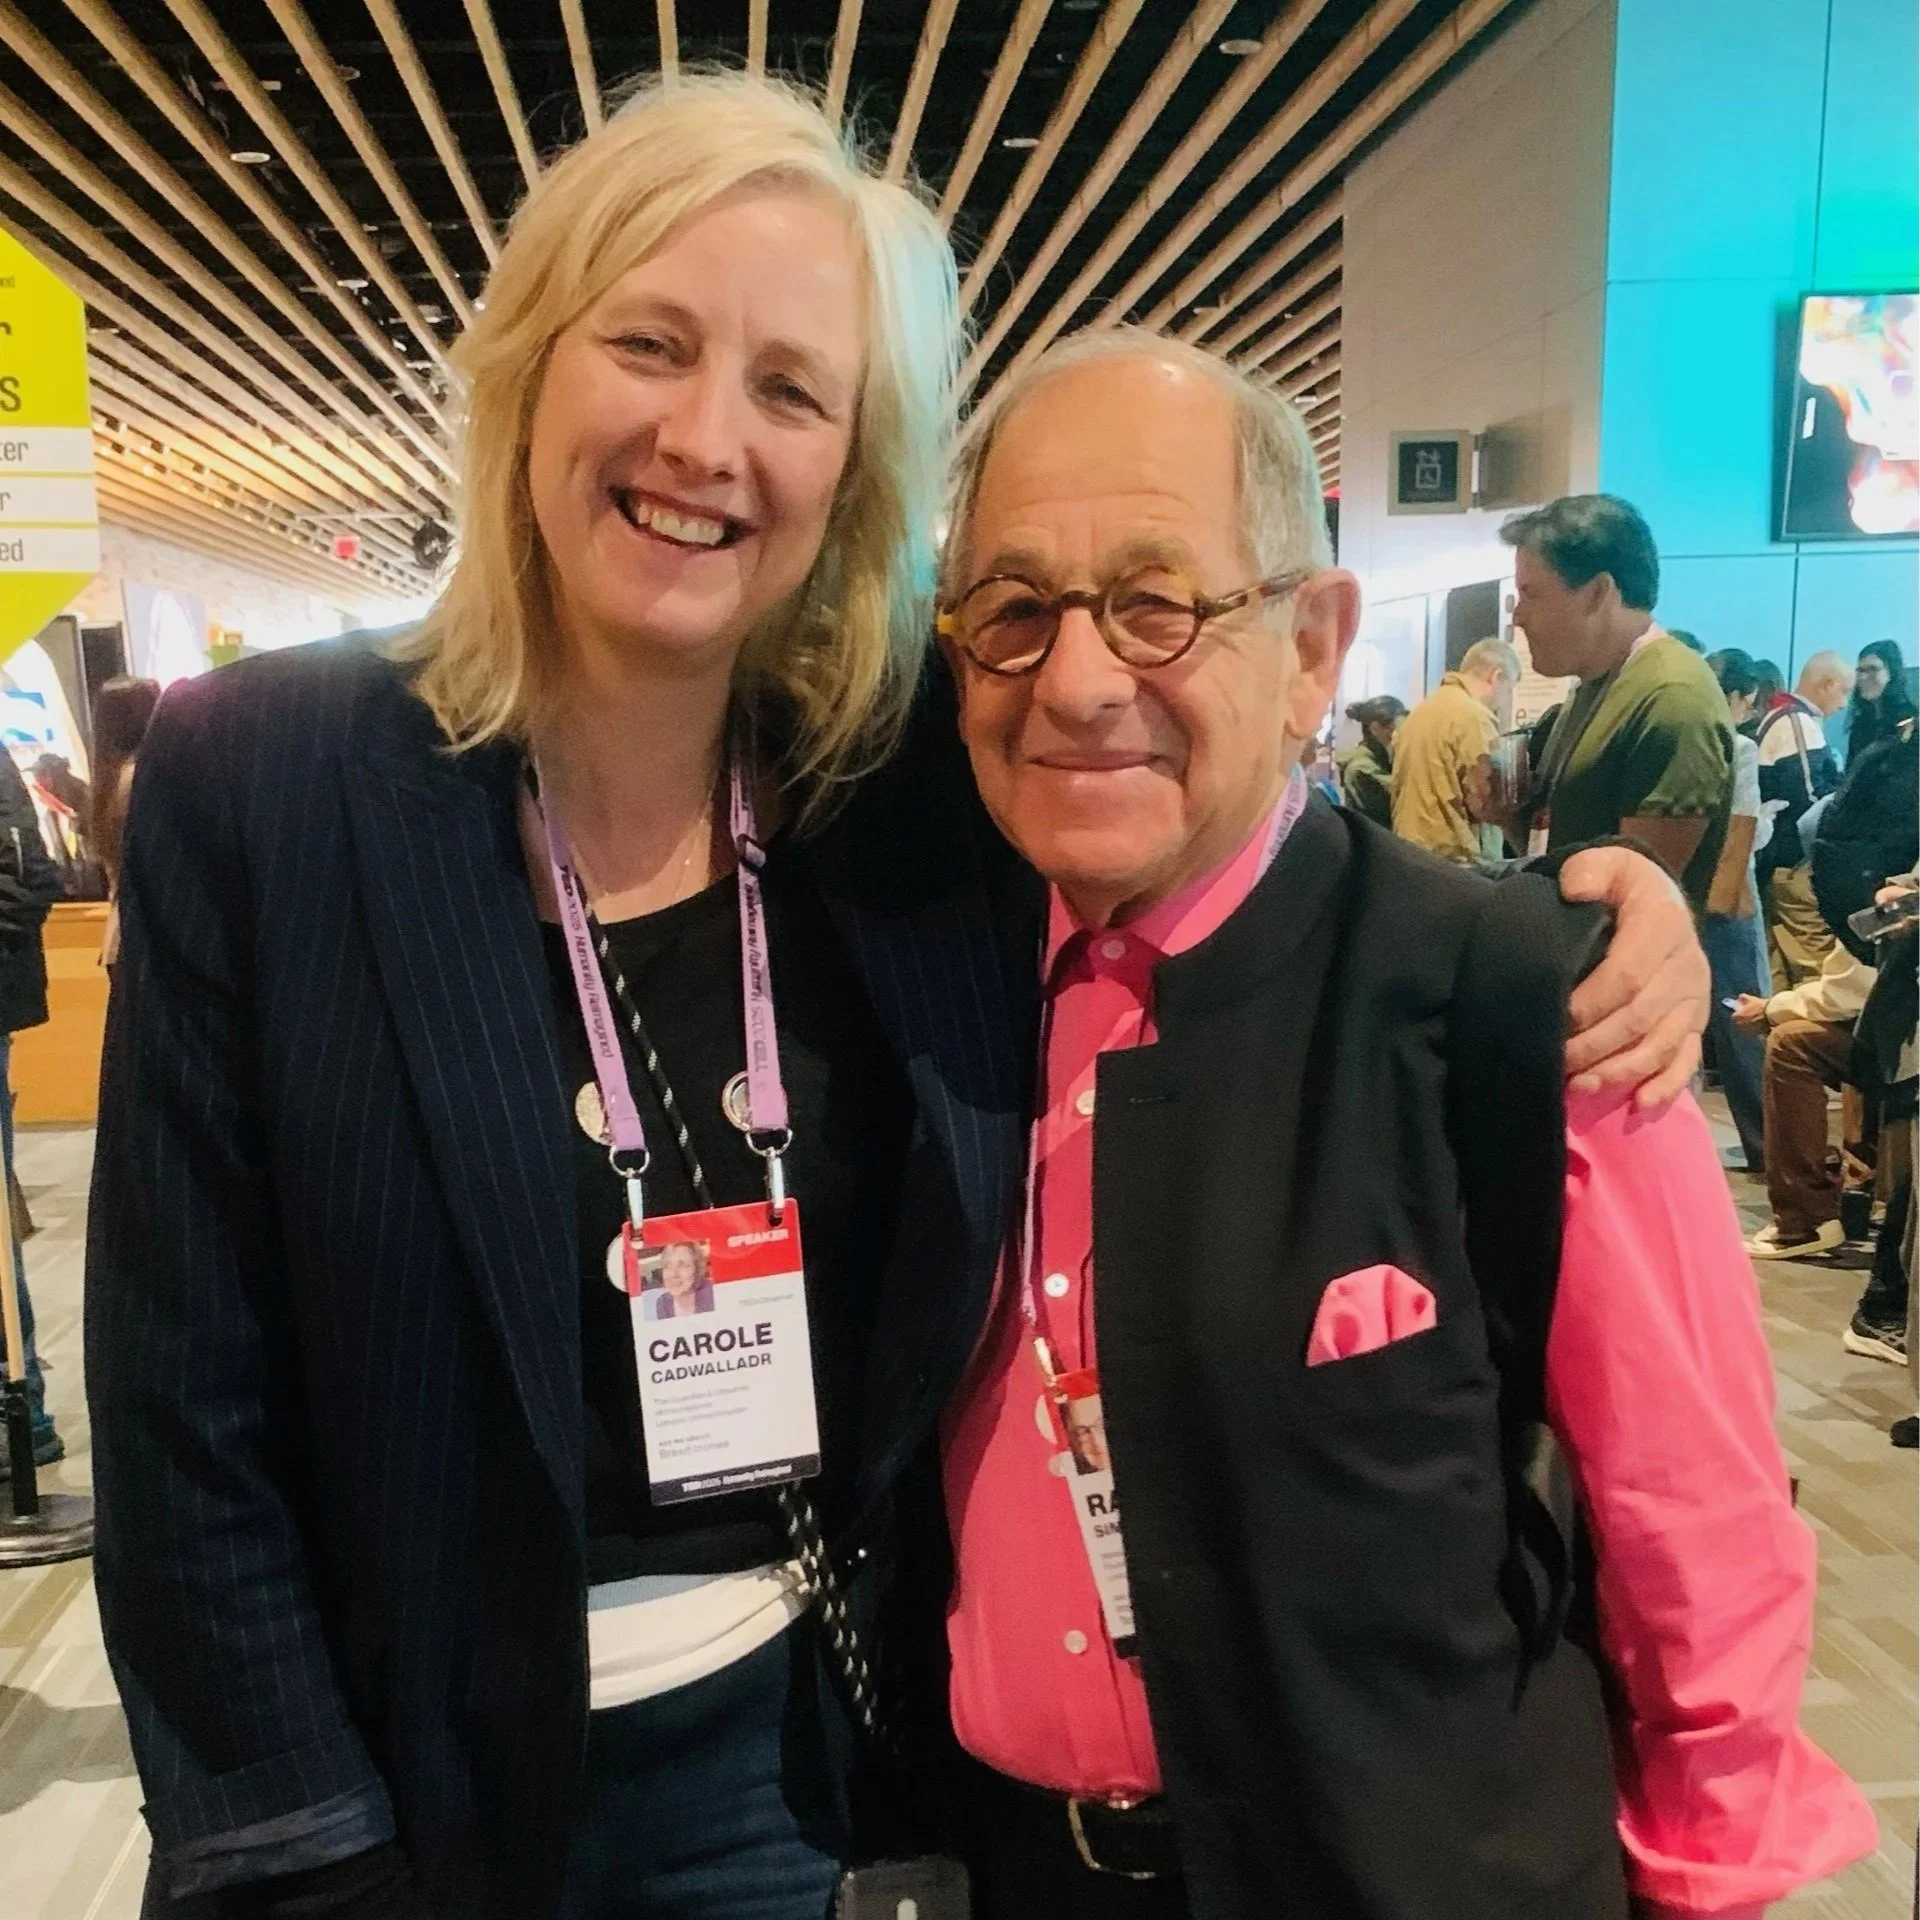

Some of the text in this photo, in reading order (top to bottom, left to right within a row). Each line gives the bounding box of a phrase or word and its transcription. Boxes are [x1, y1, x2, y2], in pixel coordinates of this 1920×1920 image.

[727, 1228, 789, 1248] SPEAKER
[649, 1321, 774, 1363] CAROLE
[651, 1352, 772, 1384] CADWALLADR
